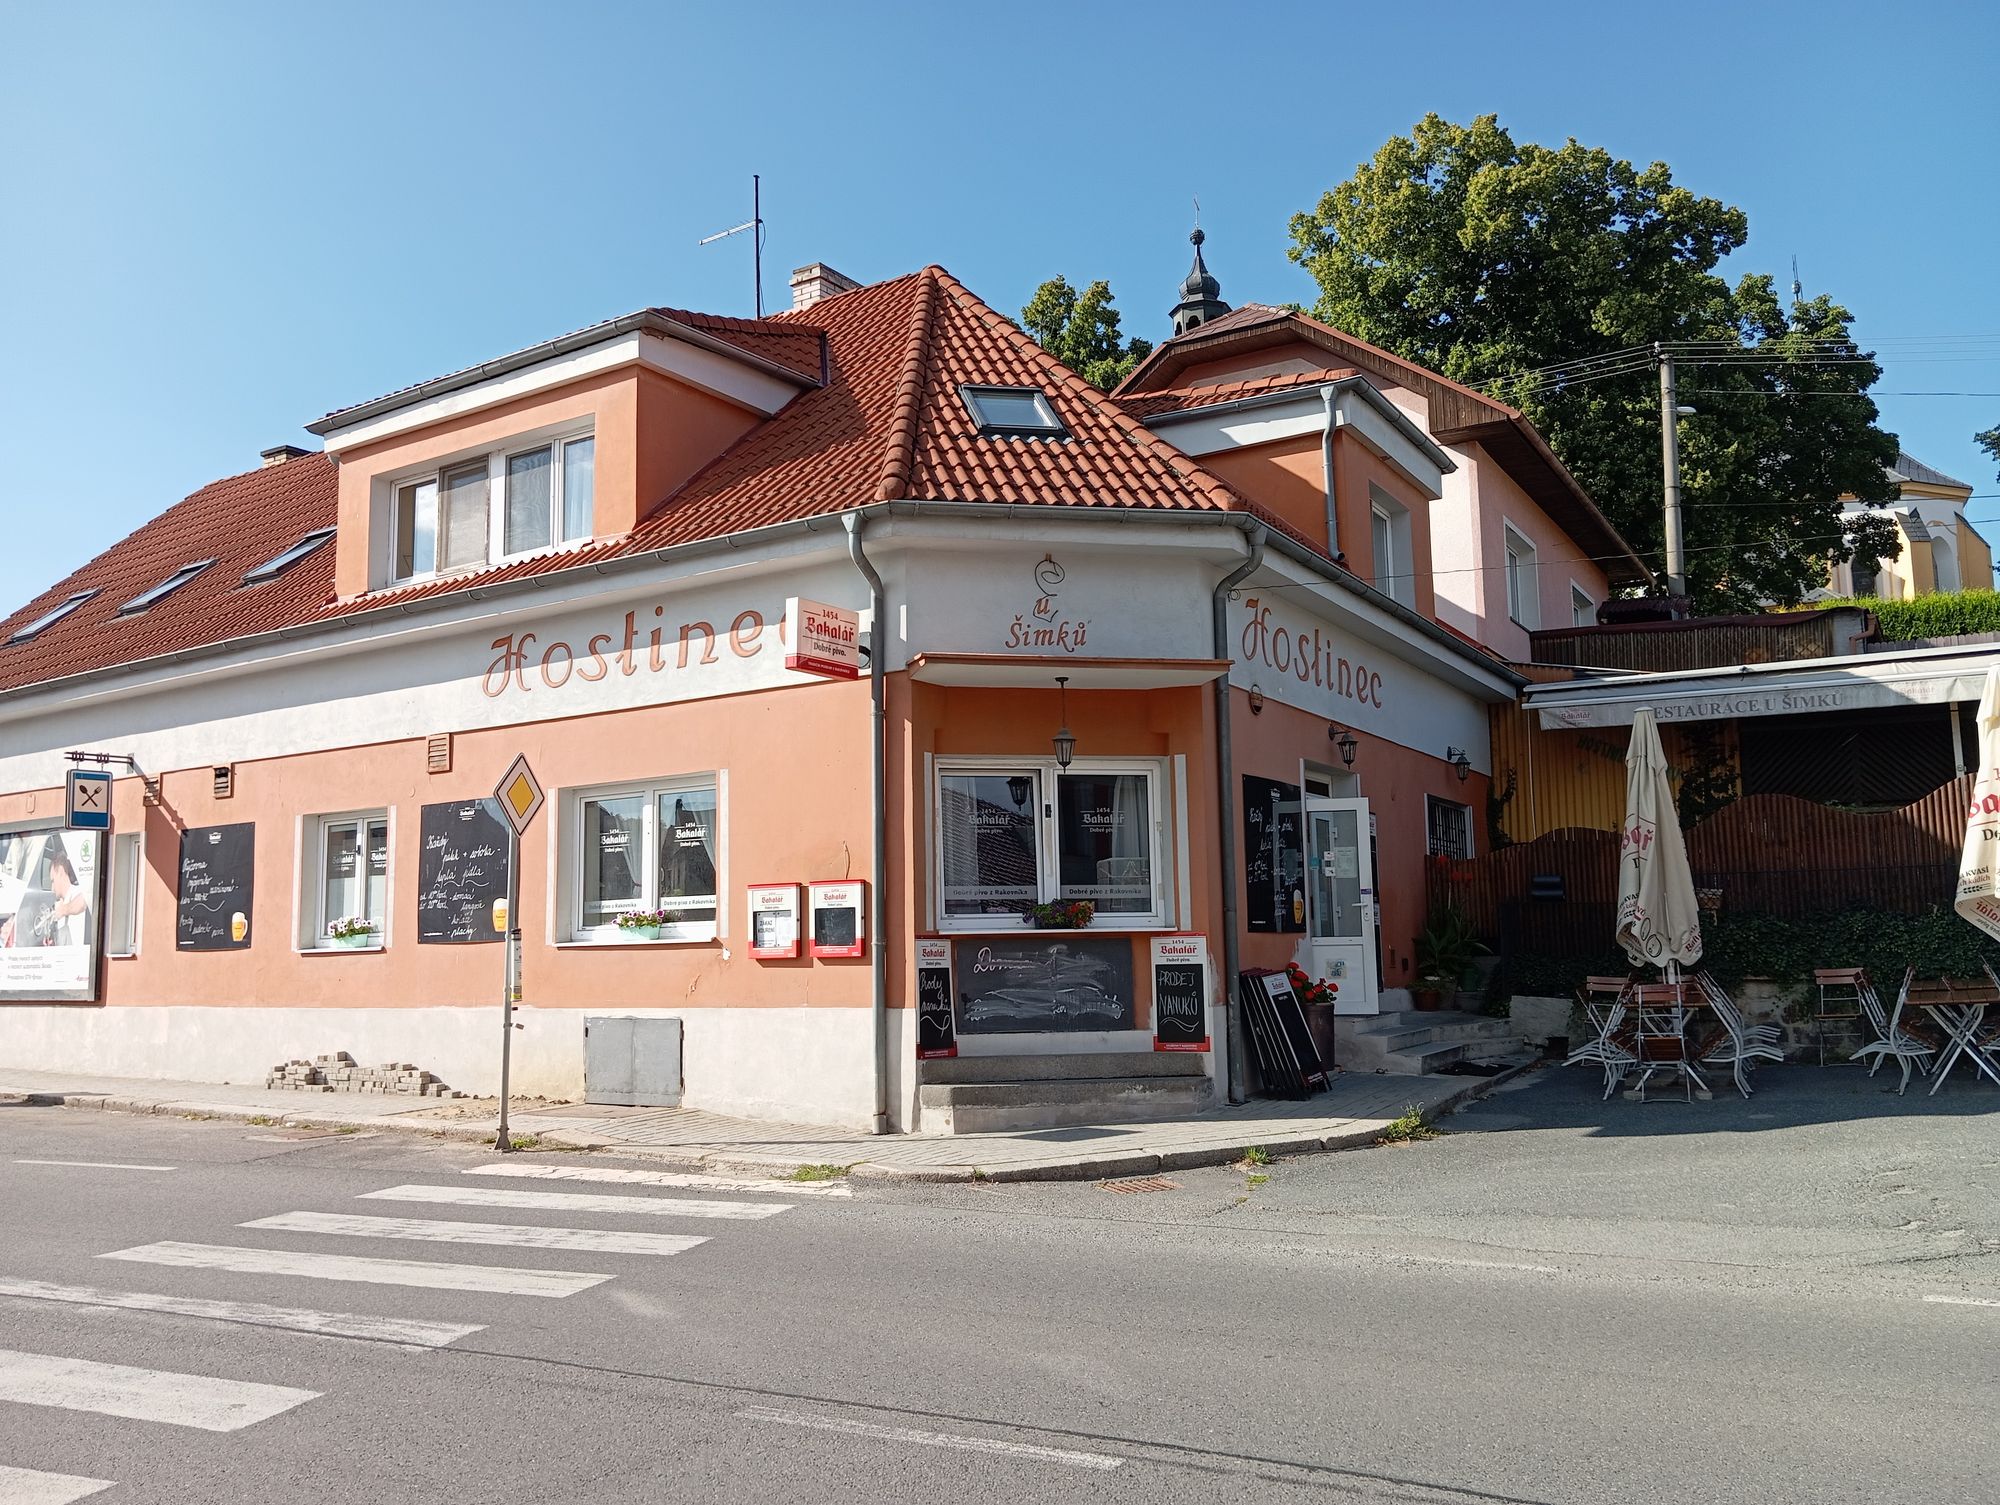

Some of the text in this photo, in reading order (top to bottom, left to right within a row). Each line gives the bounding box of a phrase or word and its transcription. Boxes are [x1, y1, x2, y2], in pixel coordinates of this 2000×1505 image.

[822, 609, 838, 620] 1454
[805, 616, 854, 642] Bakalář
[1005, 614, 1087, 653] Šimků
[482, 605, 785, 698] Hostine
[813, 641, 831, 653] Dobré
[1241, 598, 1382, 709] Hostinec
[1652, 689, 1844, 719] ESTAURACE U ŠIMKŮ
[968, 814, 1011, 825] Bakalář
[675, 827, 706, 839] Bakalář
[1069, 887, 1088, 896] Dobré
[922, 948, 945, 958] Bakalář
[1161, 945, 1197, 955] Bakalář
[1158, 970, 1195, 987] PRODEJ
[1159, 991, 1198, 1016] NANUKŮ
